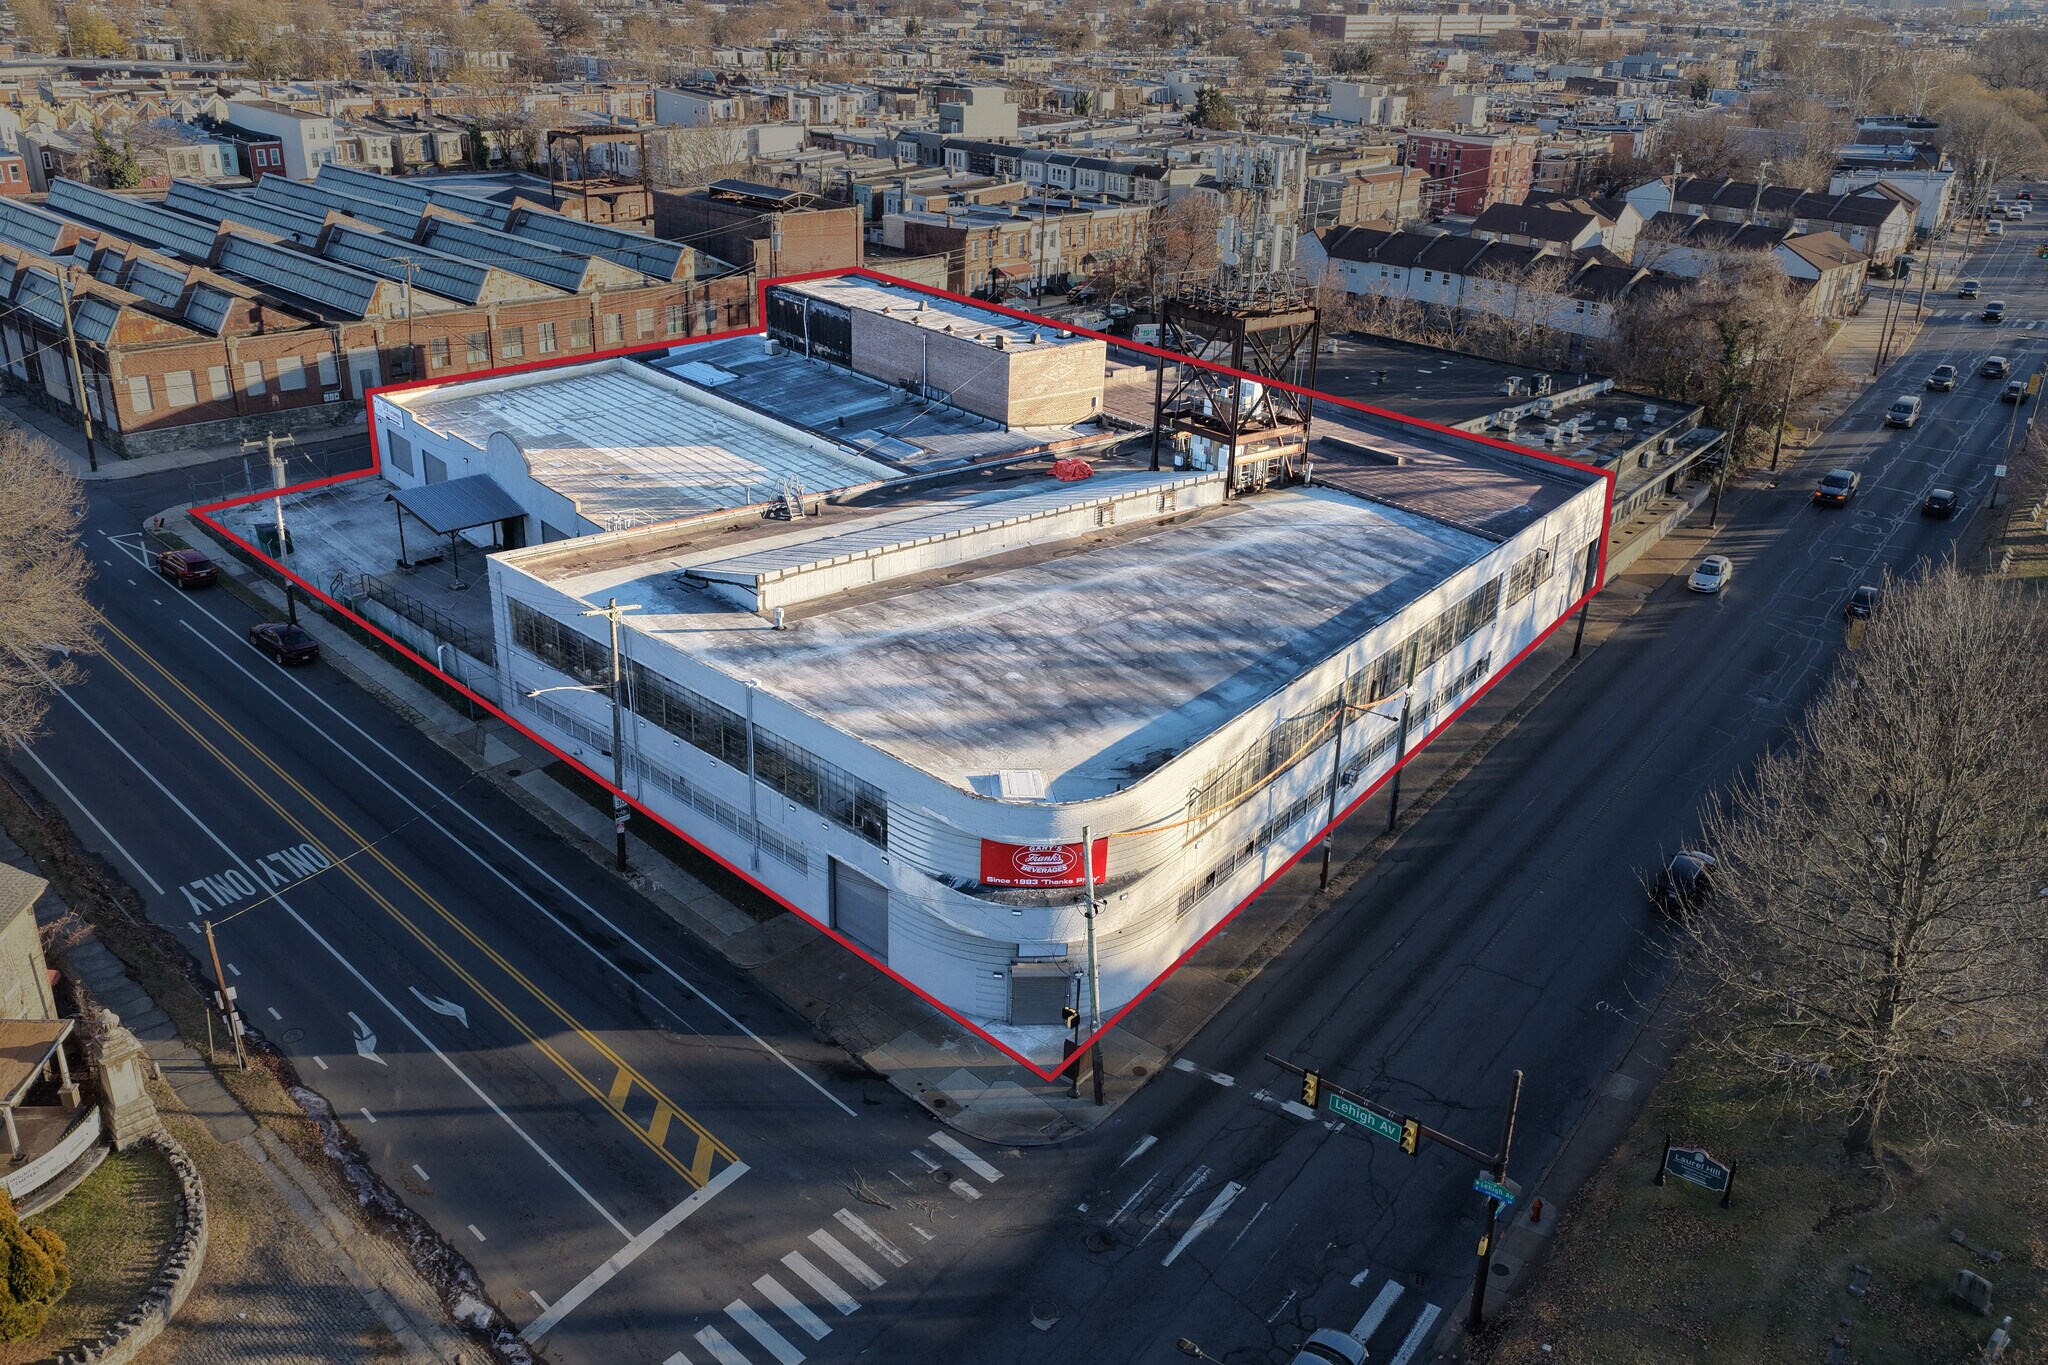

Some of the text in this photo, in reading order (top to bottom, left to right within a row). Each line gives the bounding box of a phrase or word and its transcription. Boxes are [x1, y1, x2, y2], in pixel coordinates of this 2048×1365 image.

[255, 843, 331, 887] ONLY
[1021, 864, 1068, 873] BEVERAGES
[986, 876, 1011, 884] Since
[178, 869, 257, 916] ONLY
[1335, 1099, 1396, 1135] Lehigh Av
[1675, 1153, 1704, 1170] Laurel
[1706, 1165, 1721, 1177] Hill
[9, 1169, 31, 1183] MOUNT
[1480, 1182, 1503, 1195] Lehigh
